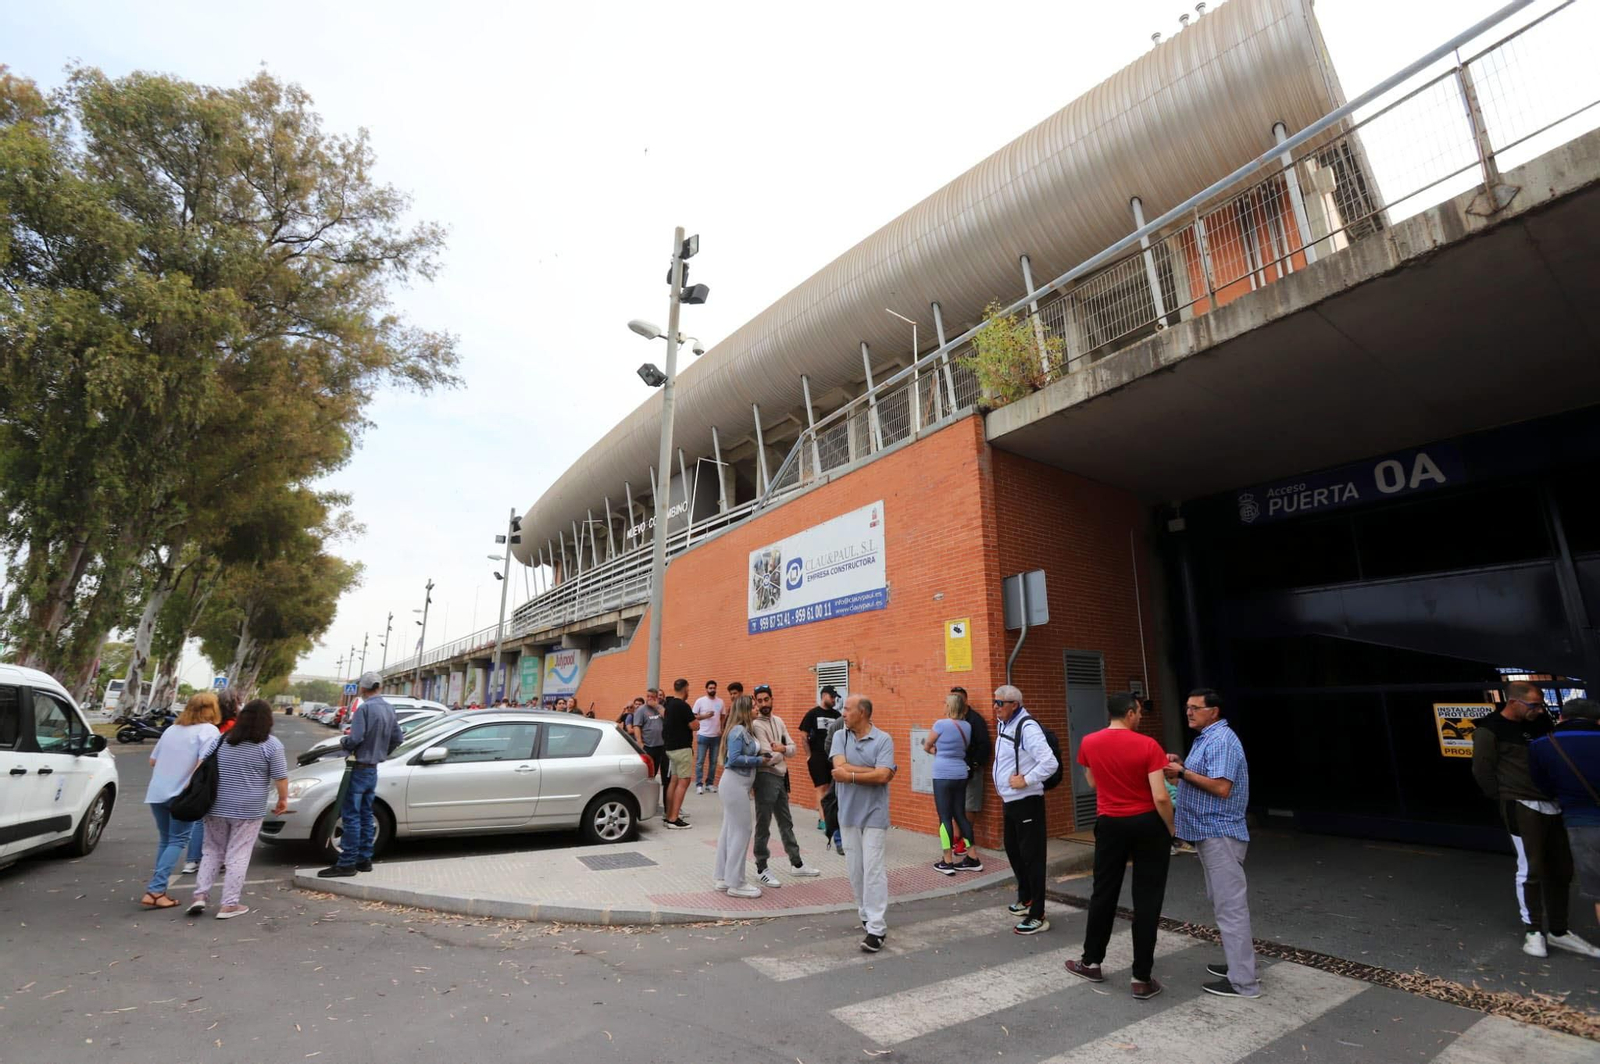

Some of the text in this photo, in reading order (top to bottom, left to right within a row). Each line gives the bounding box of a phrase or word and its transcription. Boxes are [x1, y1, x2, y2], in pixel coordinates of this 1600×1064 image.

[1267, 482, 1307, 498] Acceso
[1268, 481, 1360, 516] PUERTA
[626, 521, 646, 540] NUEVO
[807, 556, 876, 583] EMPRESA CONSTRUCTORA
[760, 617, 769, 631] 959
[795, 608, 806, 623] 959
[806, 606, 814, 621] 61
[815, 604, 823, 619] 00
[824, 602, 832, 616] 11
[1437, 705, 1492, 713] INSTALACIÓN
